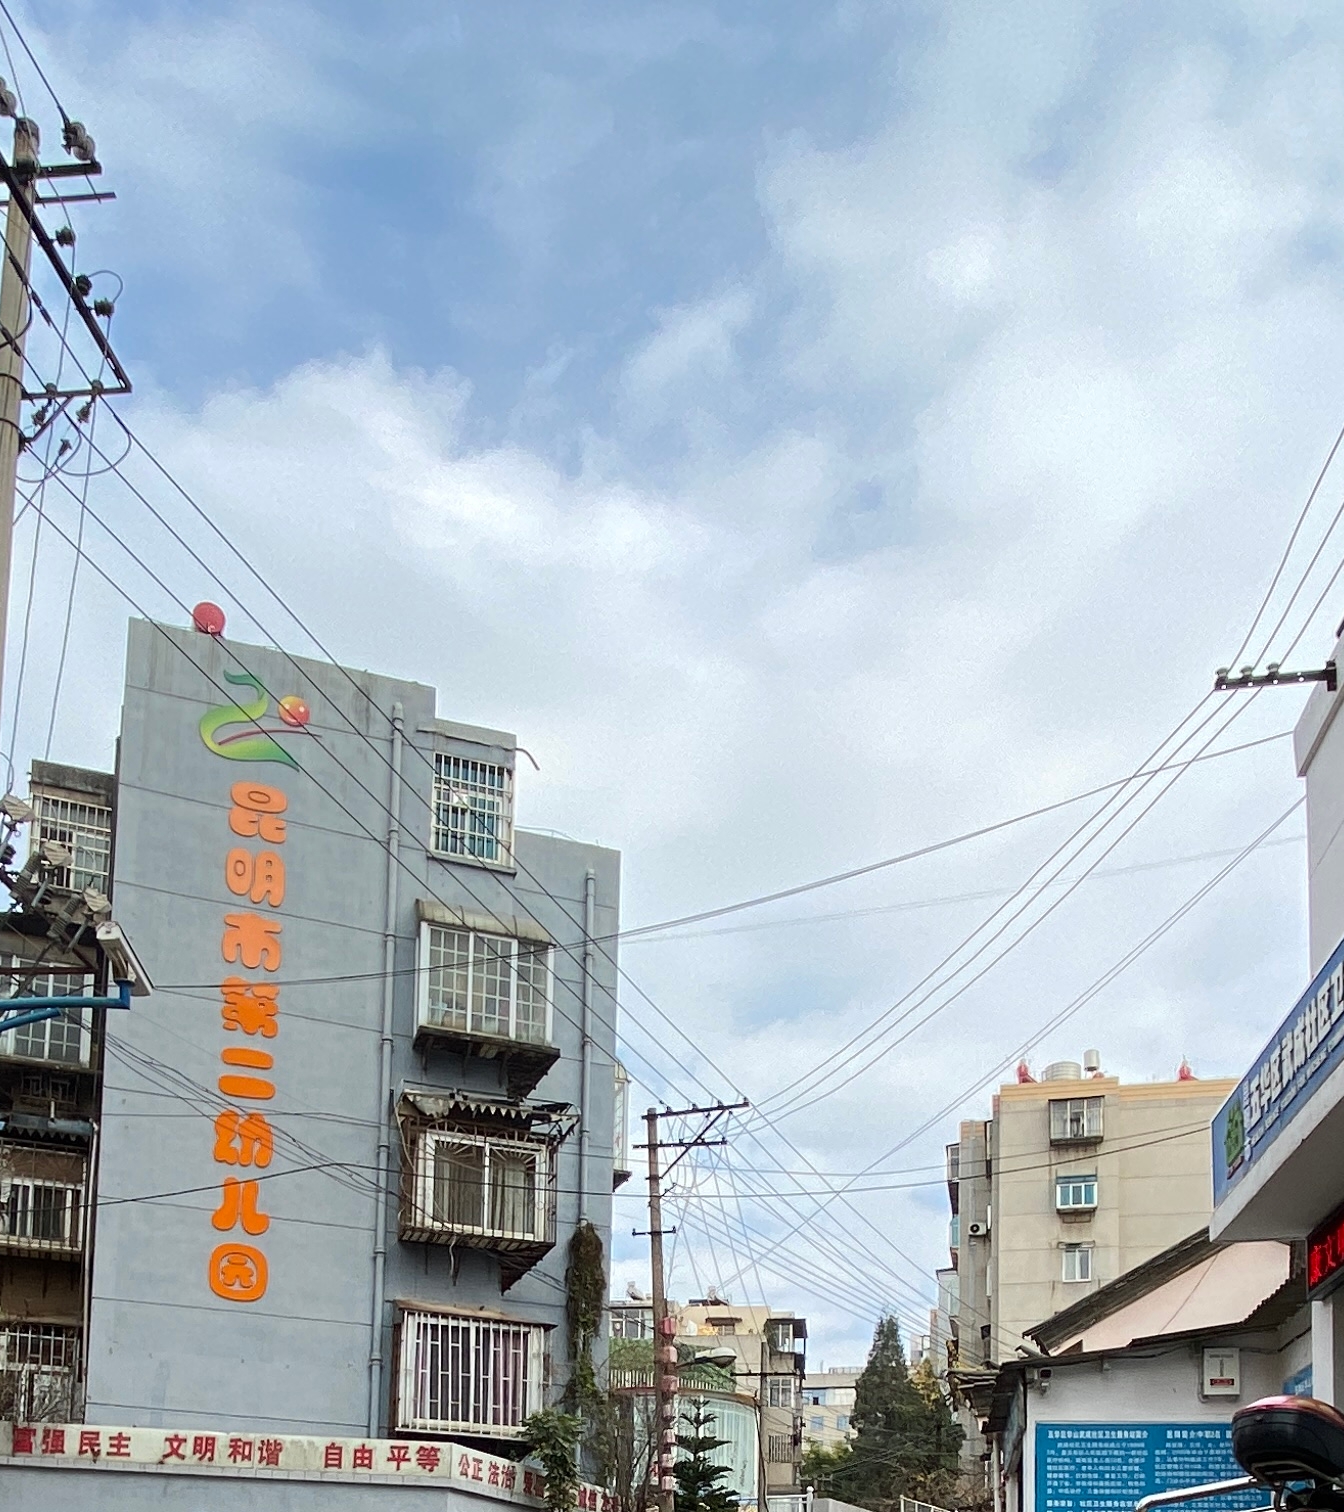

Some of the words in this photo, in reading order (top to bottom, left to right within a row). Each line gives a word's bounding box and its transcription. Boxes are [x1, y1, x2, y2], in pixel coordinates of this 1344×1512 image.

[208, 780, 288, 1301] 昆明市第二幼儿园
[13, 1426, 65, 1455] 富强
[78, 1431, 131, 1458] 民主
[162, 1434, 216, 1463] 文明
[228, 1438, 283, 1466] 和谐
[324, 1442, 373, 1470] 自由
[387, 1445, 440, 1473] 平等
[458, 1453, 483, 1482] 公正
